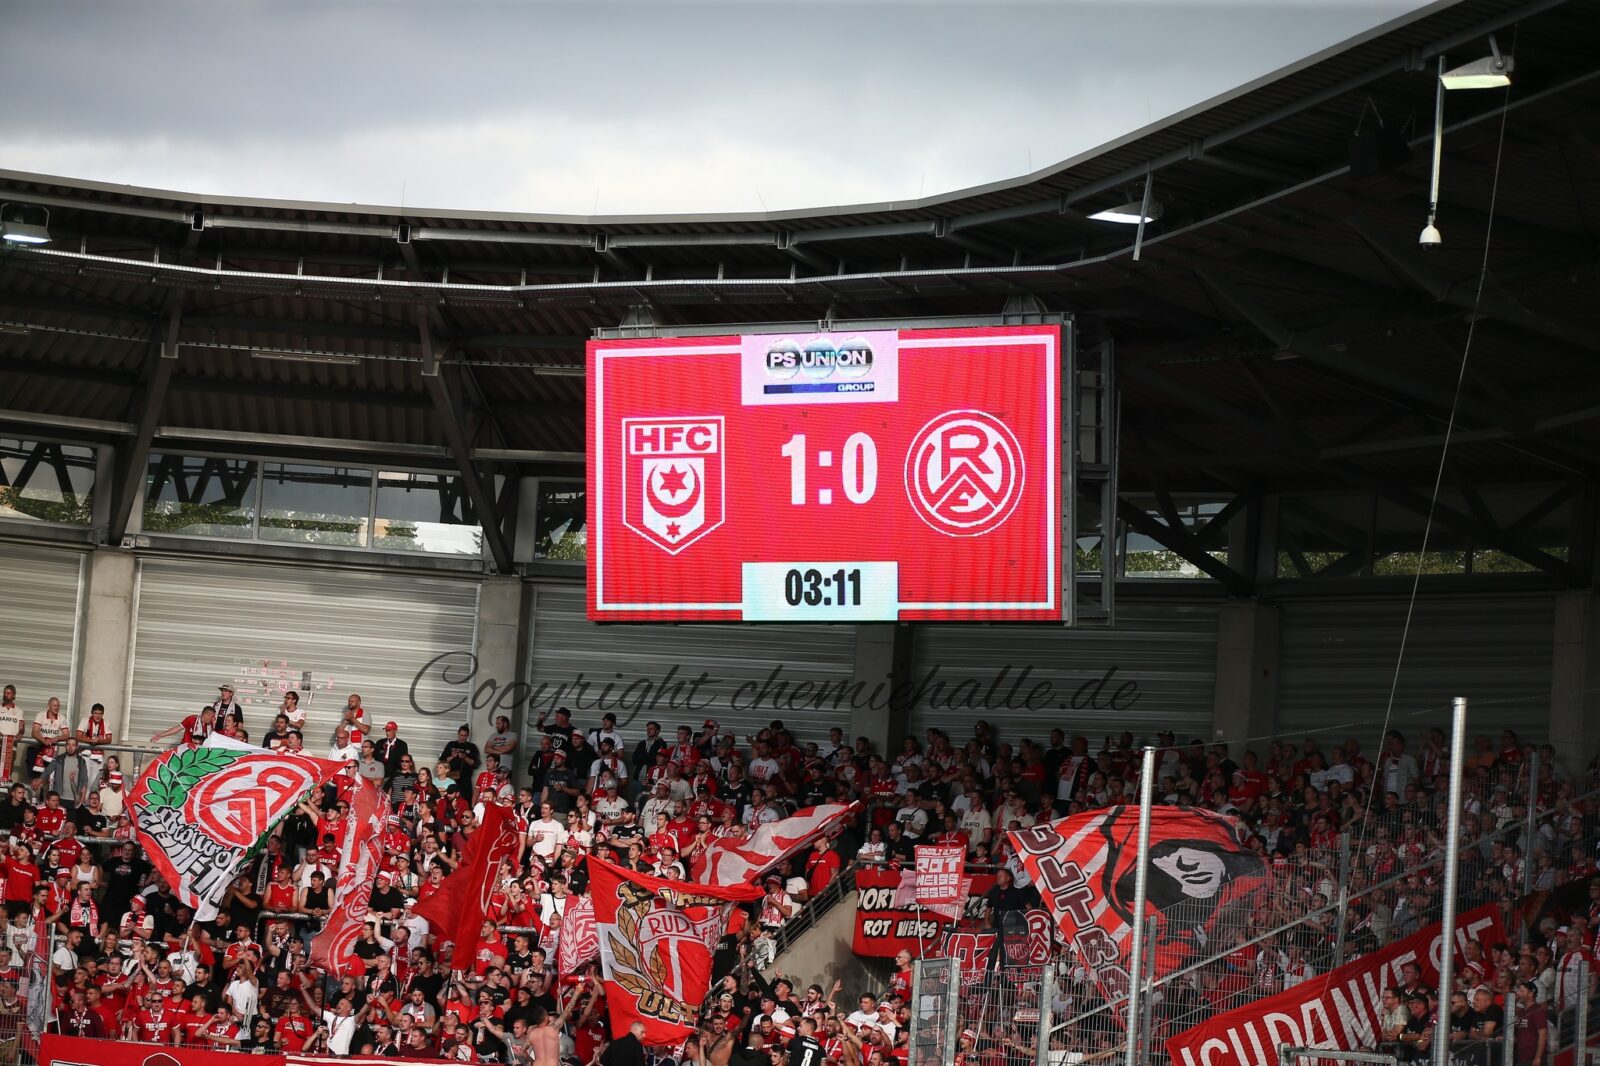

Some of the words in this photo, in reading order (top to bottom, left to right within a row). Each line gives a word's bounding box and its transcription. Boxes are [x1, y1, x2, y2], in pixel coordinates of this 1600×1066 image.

[770, 351, 796, 368] PS
[802, 350, 866, 367] UNION
[837, 383, 874, 392] GROUP
[634, 425, 713, 452] HFC
[781, 431, 878, 505] 1:0
[785, 568, 862, 606] 03:11
[916, 856, 961, 874] ROT
[863, 919, 892, 937] ROT
[896, 920, 938, 940] WEISS
